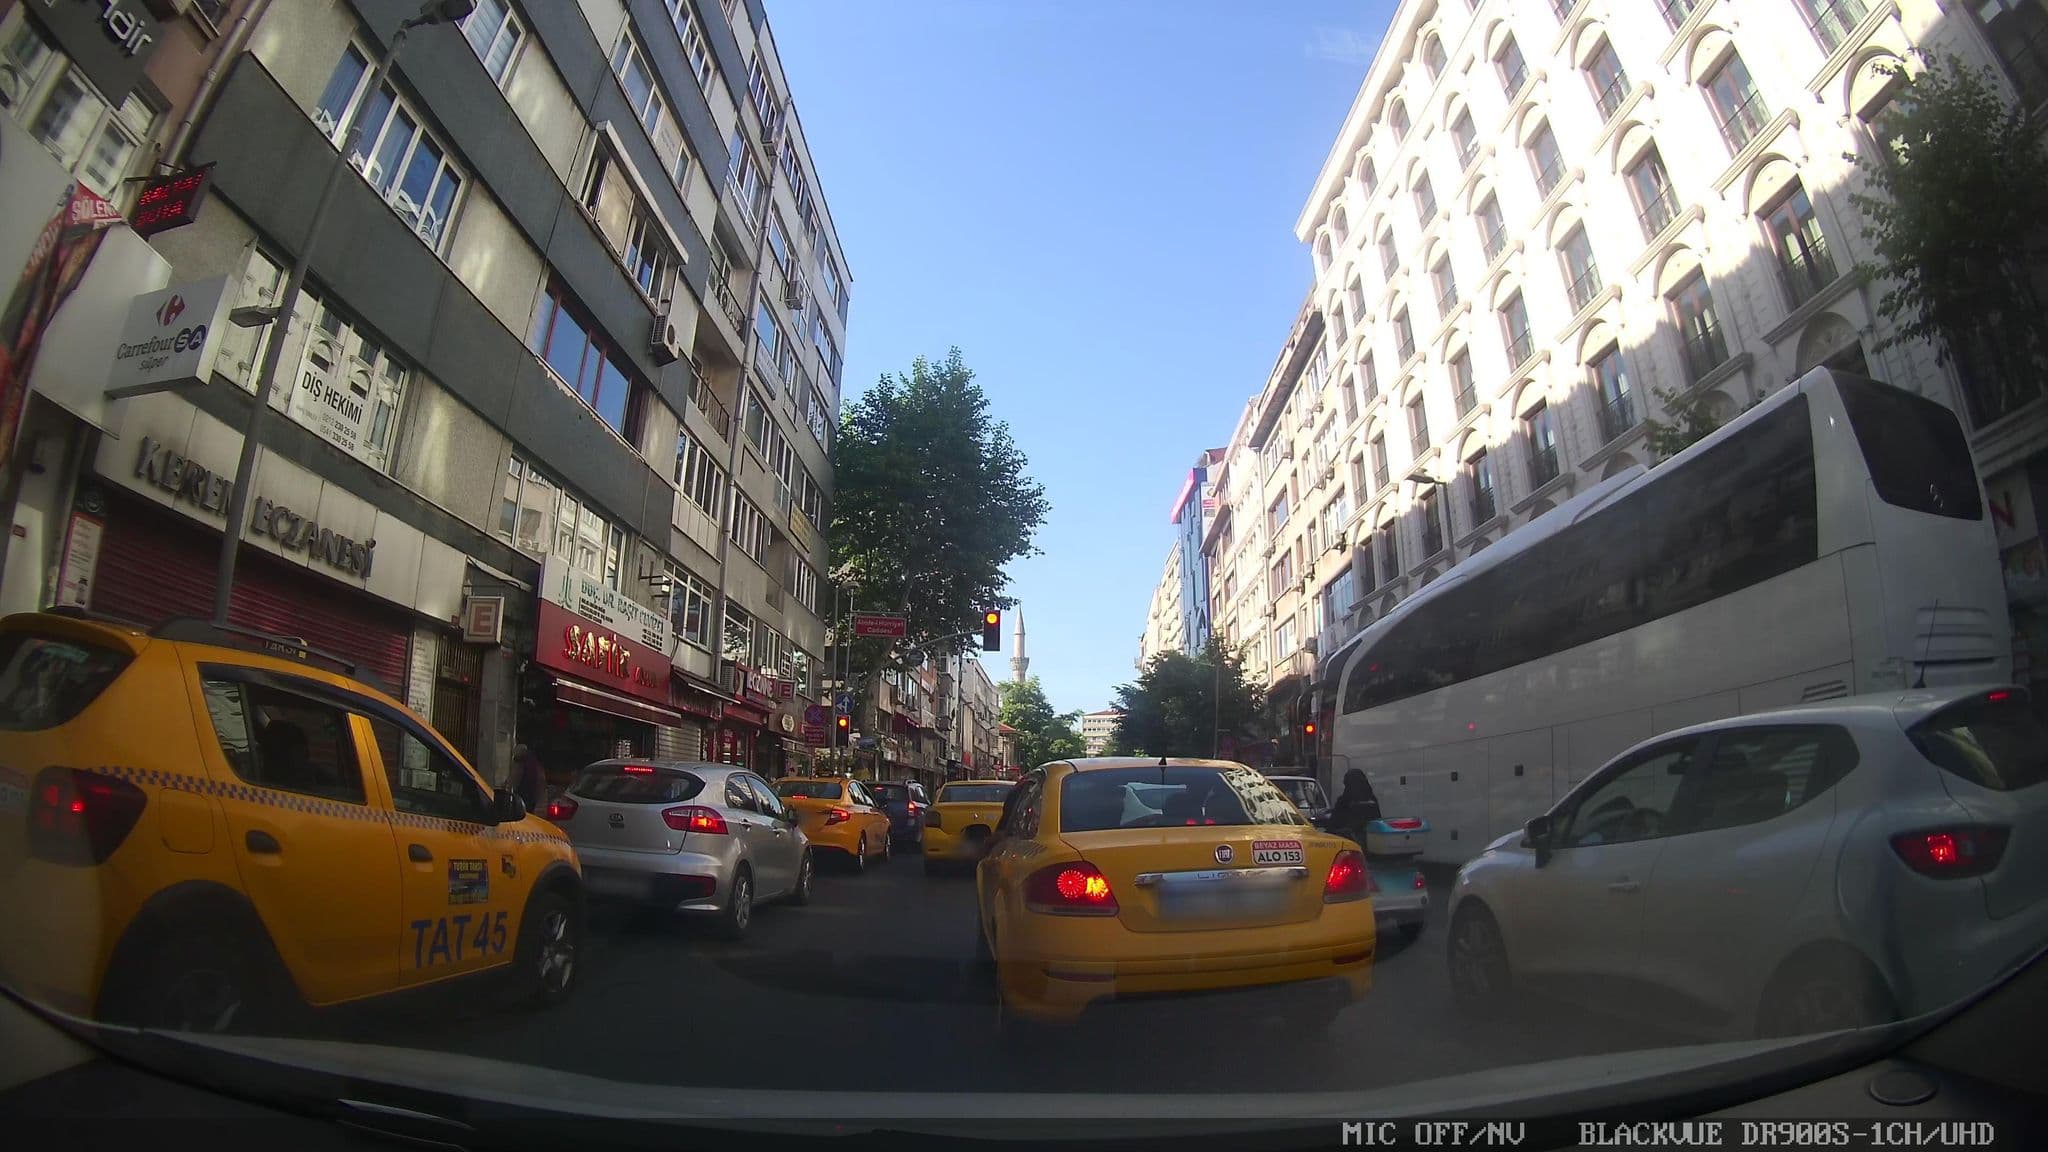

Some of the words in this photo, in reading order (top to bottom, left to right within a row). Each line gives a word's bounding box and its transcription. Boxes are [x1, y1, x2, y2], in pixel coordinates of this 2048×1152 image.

[302, 371, 323, 402] DİŞ
[323, 385, 364, 425] HEKİMİ
[1254, 841, 1278, 849] BEYAZ
[1278, 841, 1300, 849] MASA
[1257, 851, 1282, 862] ALO
[1284, 850, 1301, 862] 153
[411, 914, 473, 969] TAT
[473, 911, 508, 957] 45
